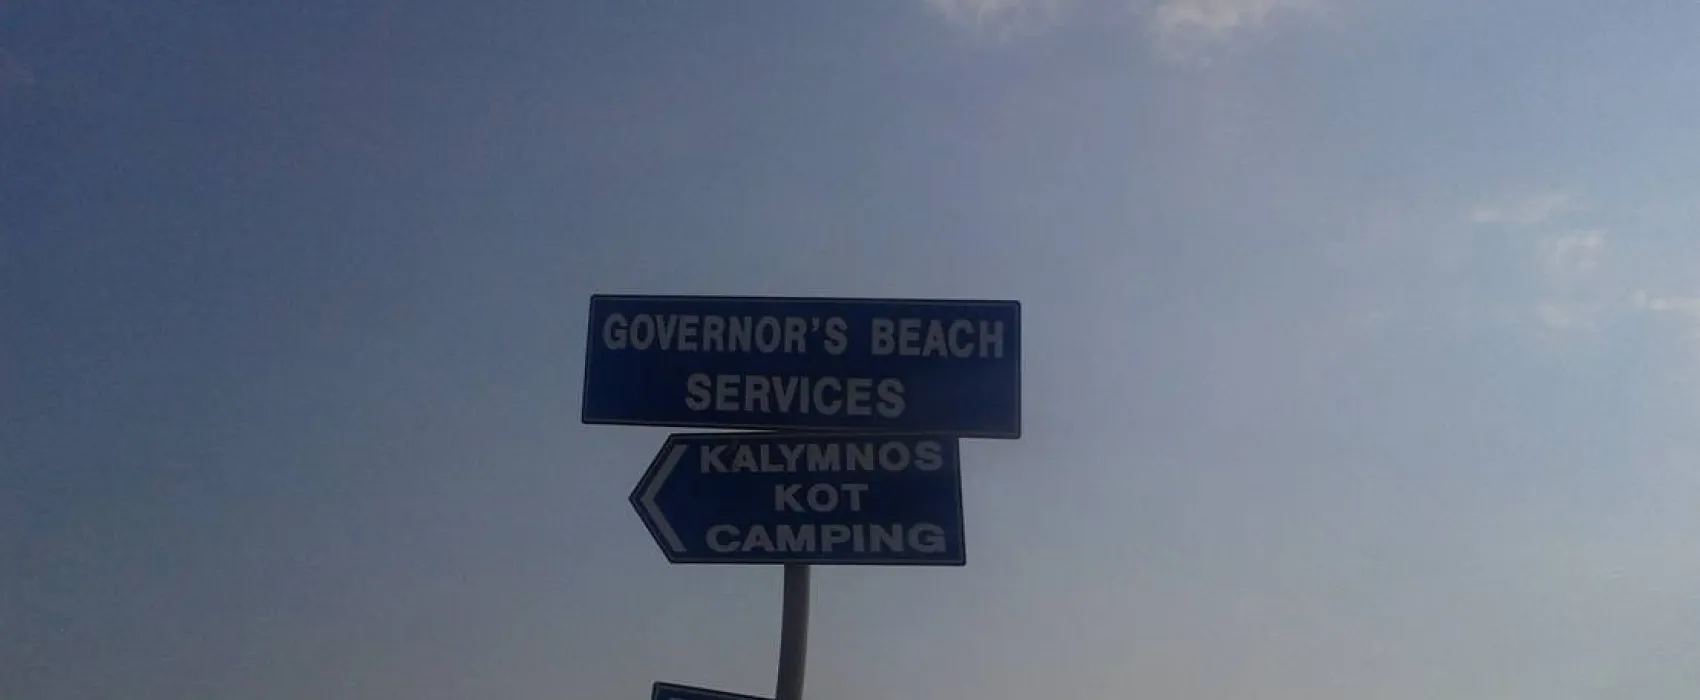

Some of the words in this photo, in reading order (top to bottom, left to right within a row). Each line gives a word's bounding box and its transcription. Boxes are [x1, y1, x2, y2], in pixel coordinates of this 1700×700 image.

[602, 312, 848, 355] GOVERNOR'S
[871, 317, 1004, 359] BEACH
[686, 373, 906, 418] SERVICES
[700, 440, 943, 473] KALYMNOS
[774, 483, 869, 513] KOT
[705, 523, 946, 554] CAMPING
